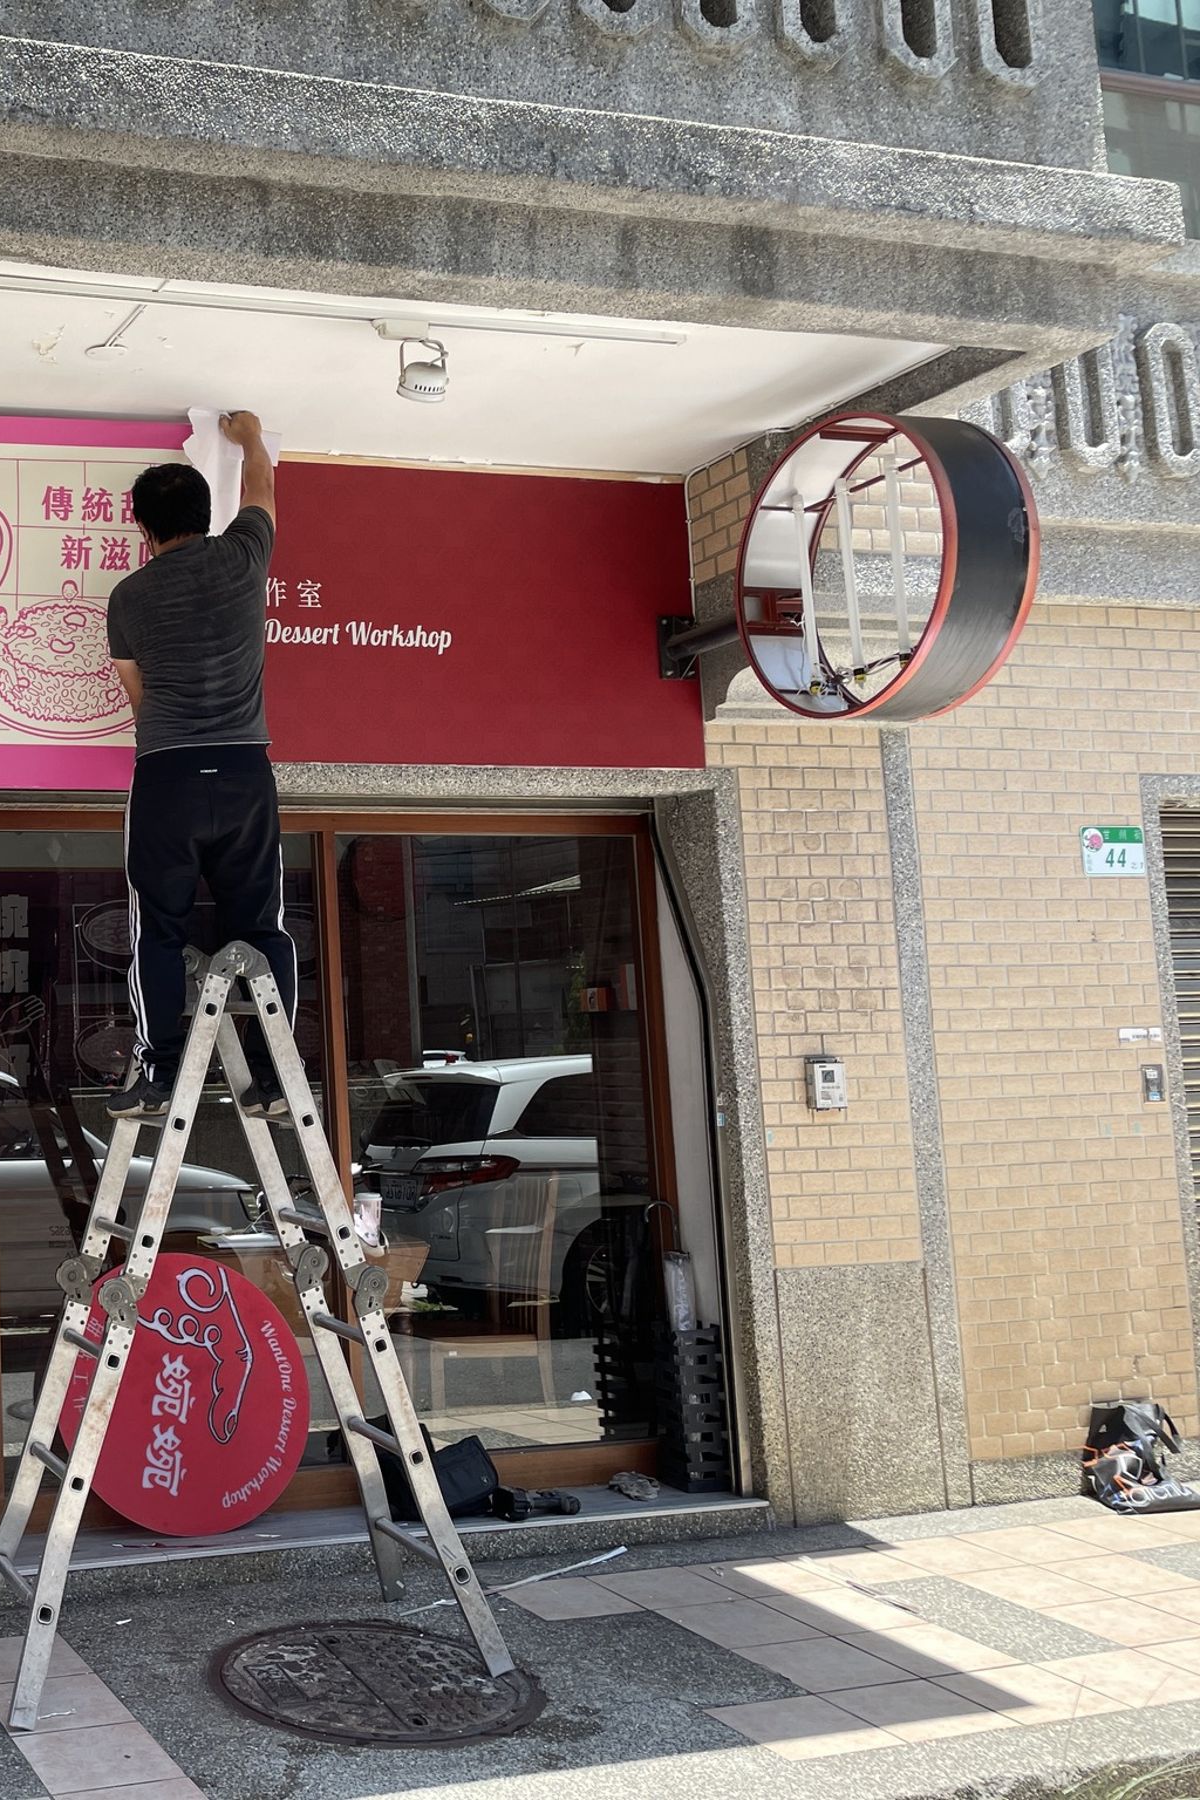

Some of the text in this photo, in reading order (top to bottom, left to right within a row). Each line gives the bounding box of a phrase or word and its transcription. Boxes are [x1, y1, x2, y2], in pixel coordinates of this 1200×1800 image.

[265, 577, 323, 608] 作室
[265, 619, 452, 655] Dessert Workshop
[1105, 848, 1126, 868] 44
[222, 1319, 297, 1509] WantOne Dessert Workshop
